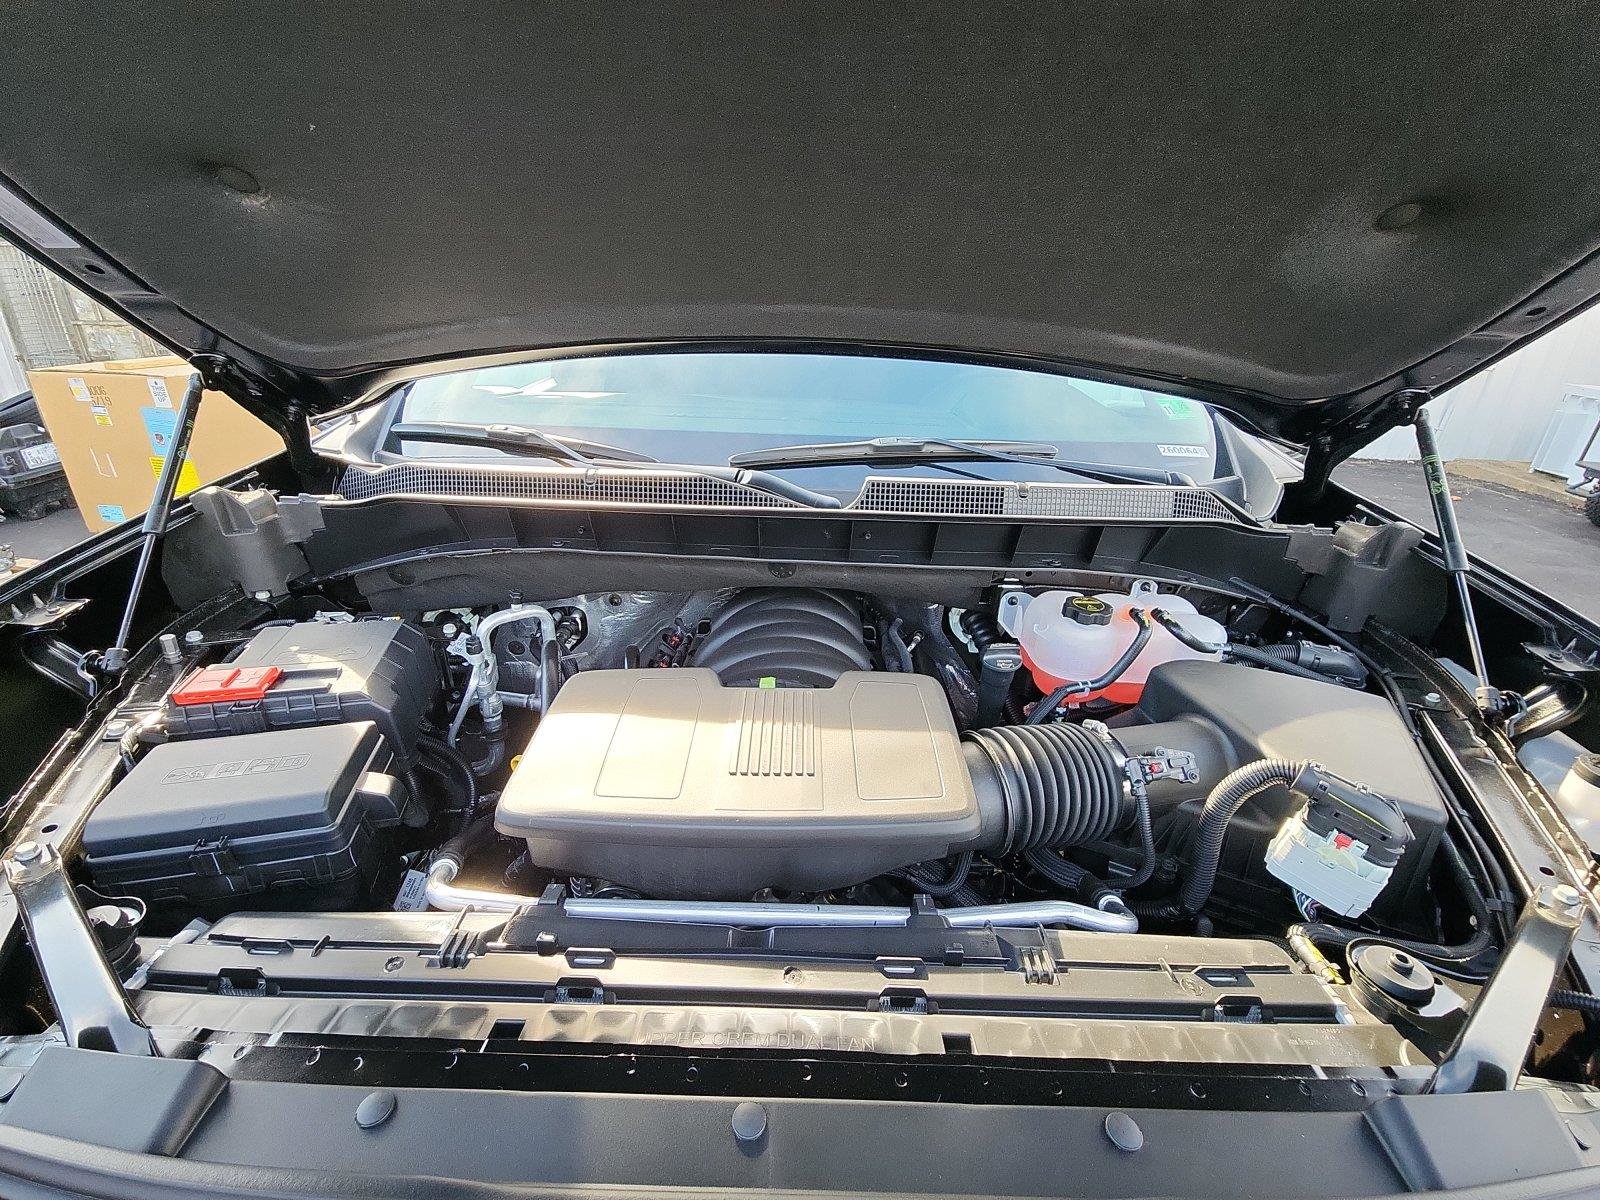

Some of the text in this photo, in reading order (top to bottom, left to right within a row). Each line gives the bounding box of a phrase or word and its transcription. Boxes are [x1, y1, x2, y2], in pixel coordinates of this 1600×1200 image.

[636, 1031, 706, 1046] UPPER
[777, 1033, 831, 1050] DUAL
[837, 1035, 876, 1052] FAN
